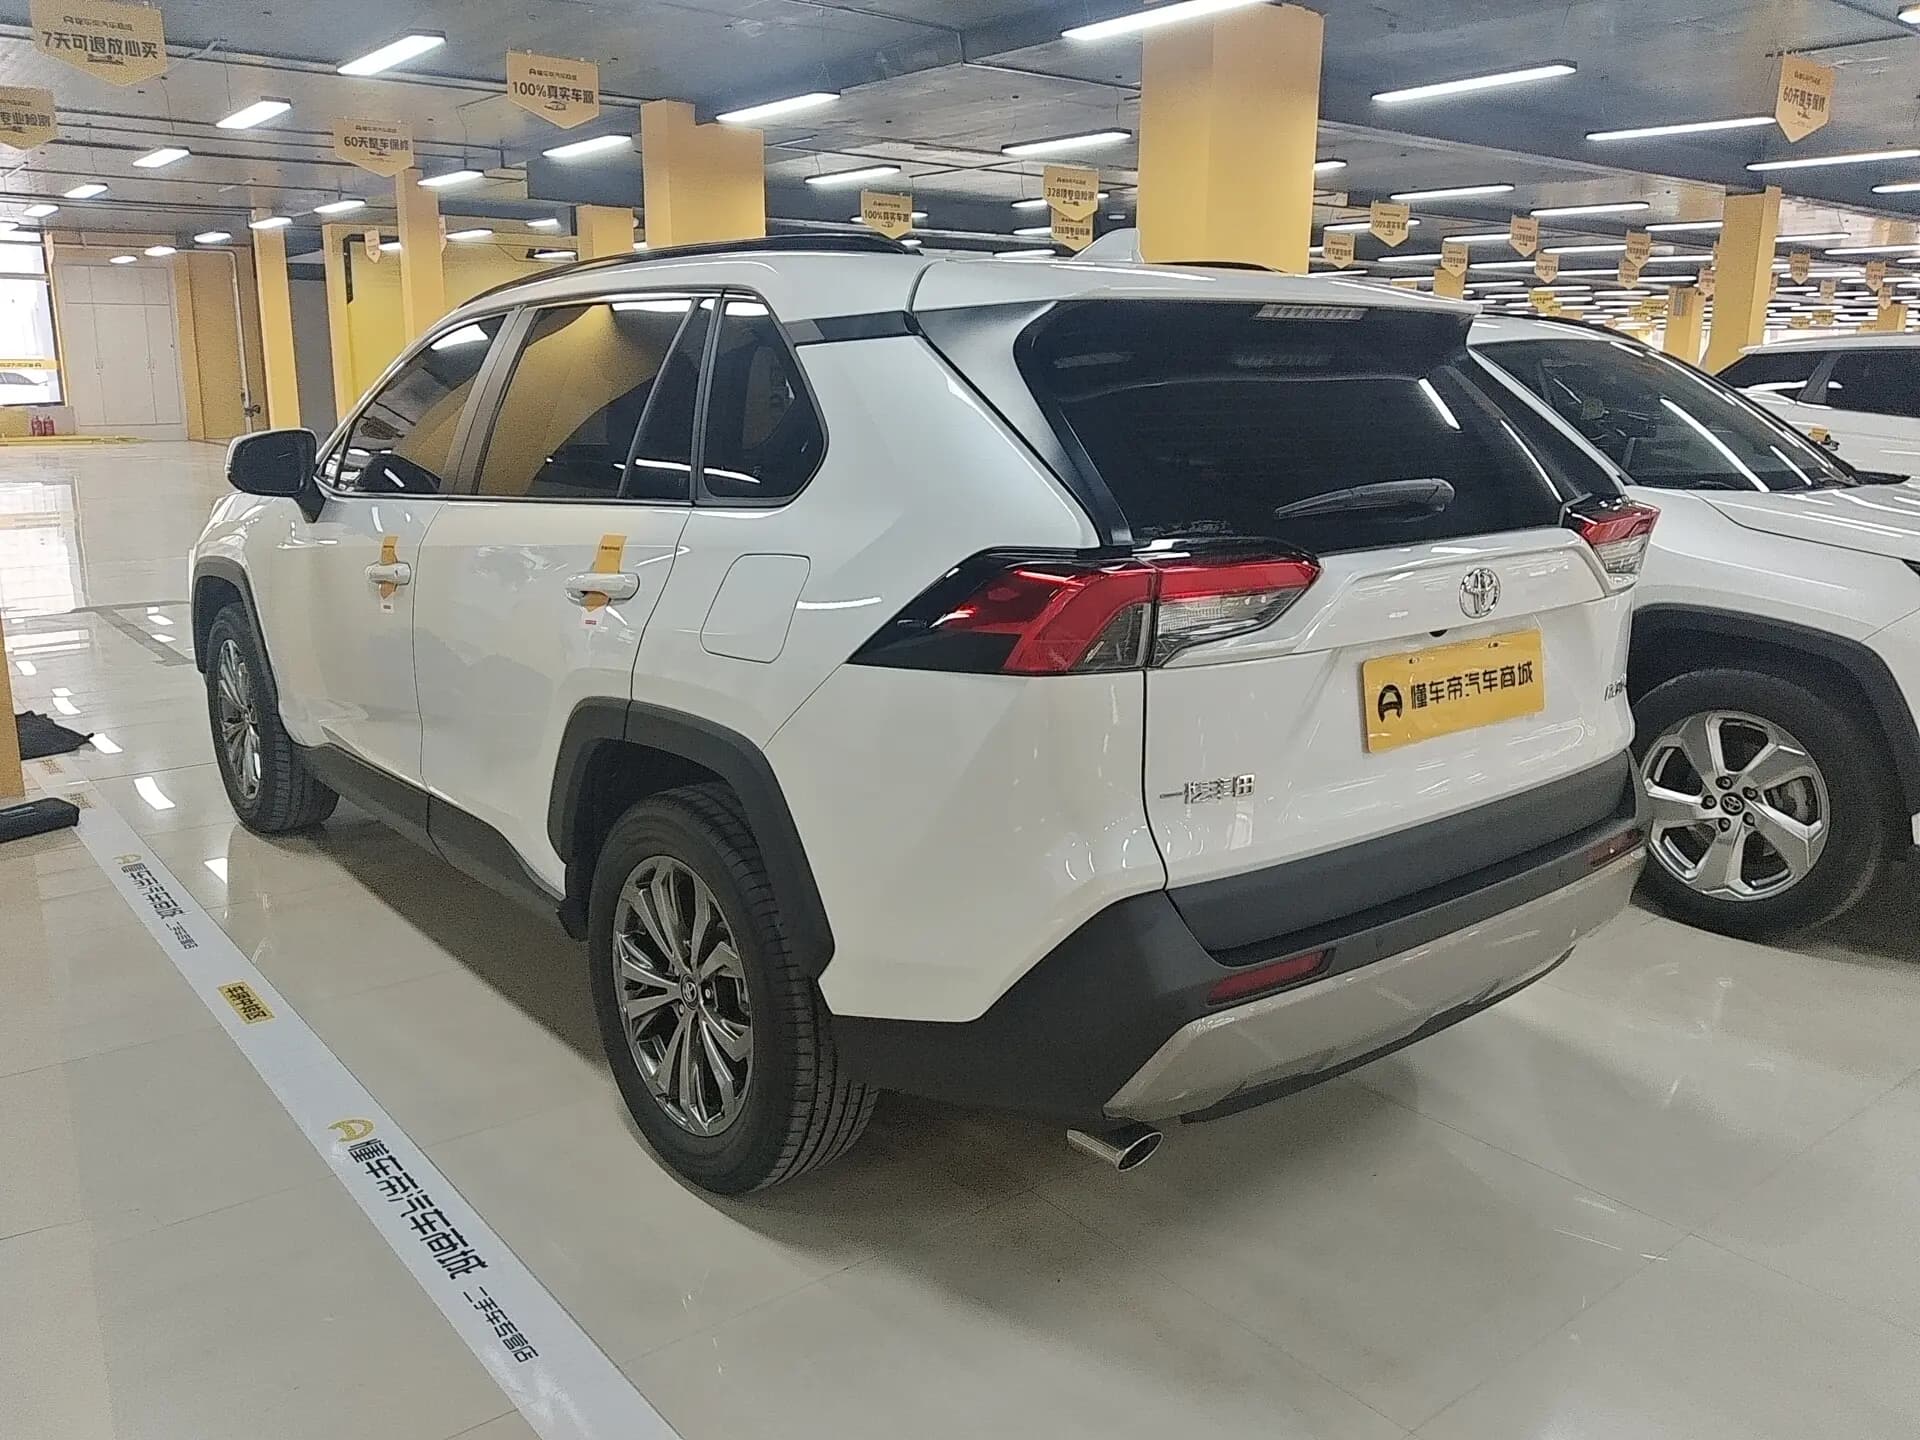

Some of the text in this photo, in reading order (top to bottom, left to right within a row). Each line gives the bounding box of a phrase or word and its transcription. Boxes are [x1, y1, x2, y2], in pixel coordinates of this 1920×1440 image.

[41, 31, 158, 59] 7天可退放心买
[512, 81, 594, 104] 100%真实车源
[1410, 660, 1533, 709] 懂车帝汽车商城
[348, 1138, 539, 1363] 懂车帝汽车商城 二手车专营店
